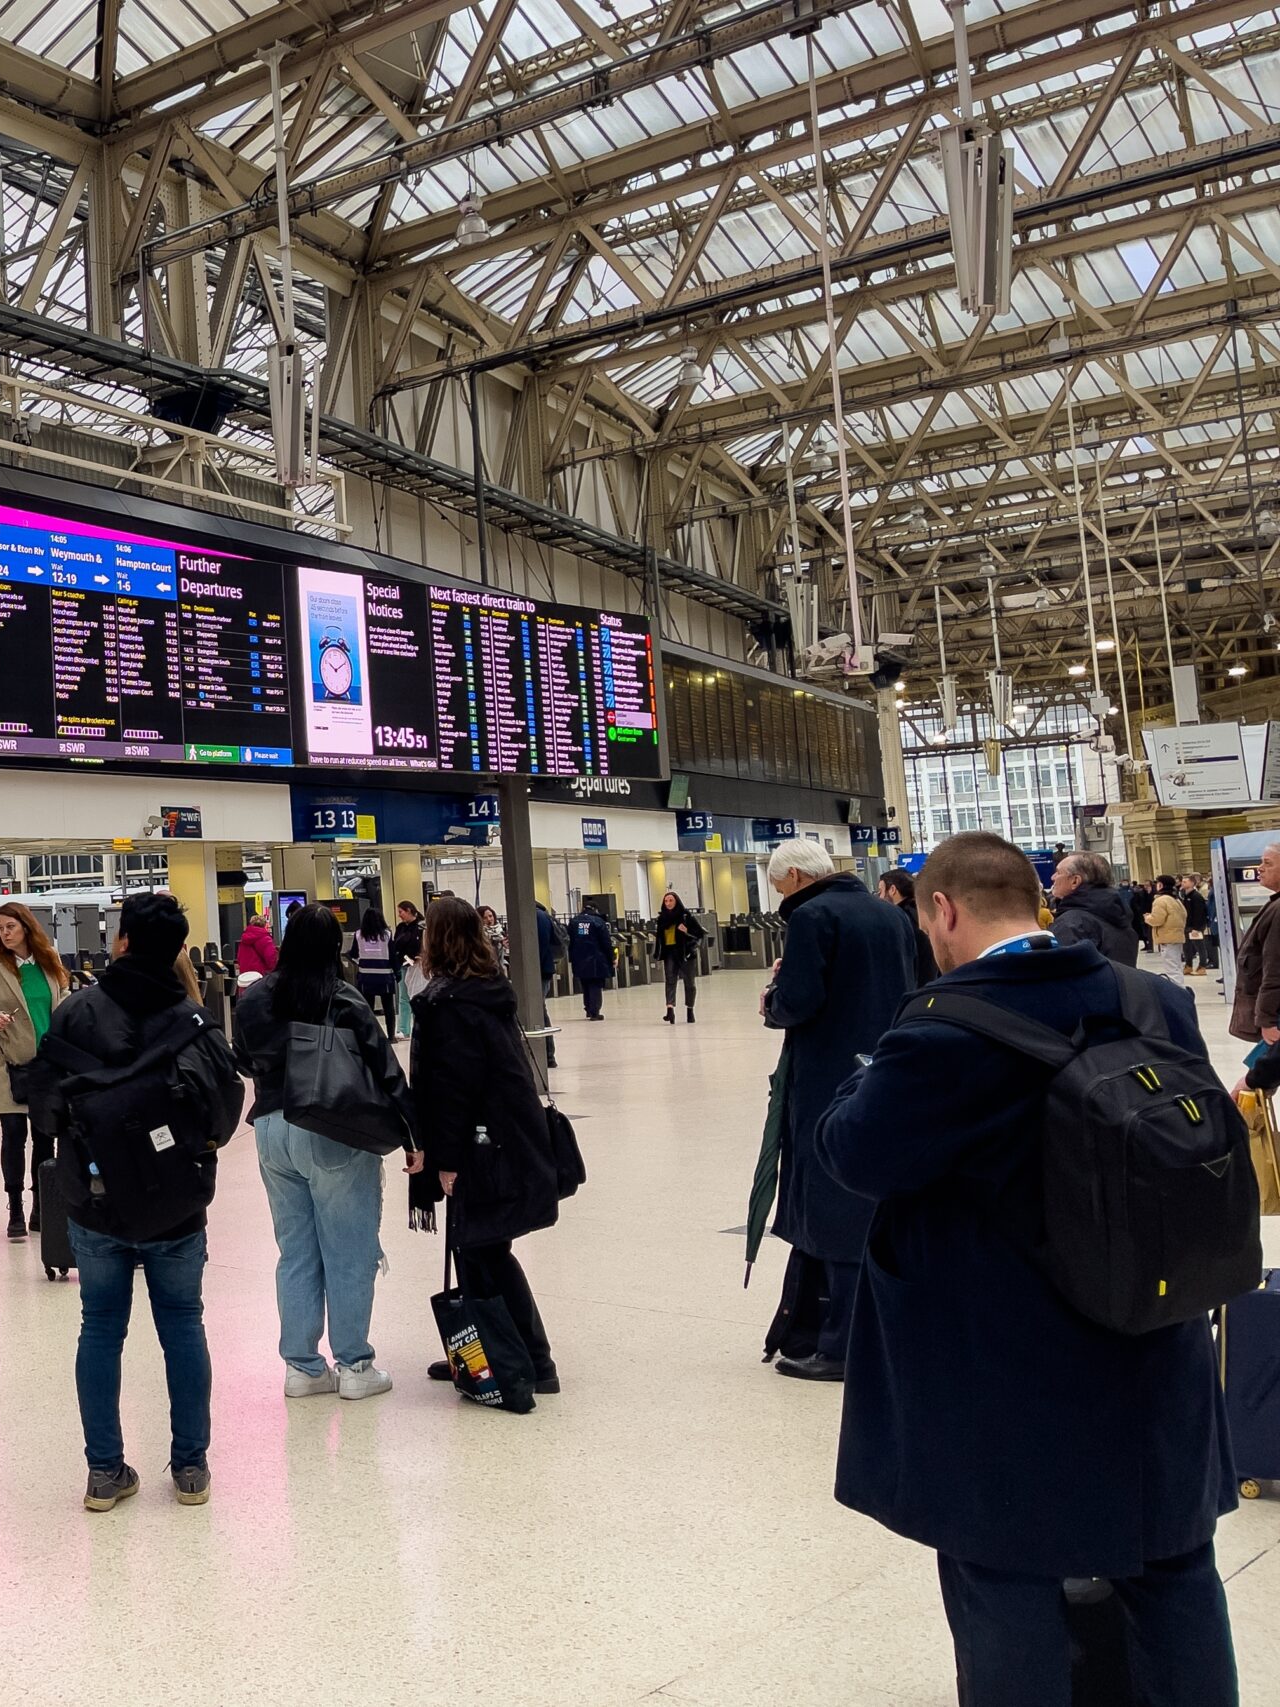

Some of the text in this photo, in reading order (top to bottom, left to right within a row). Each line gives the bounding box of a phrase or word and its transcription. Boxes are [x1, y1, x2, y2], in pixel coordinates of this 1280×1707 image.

[50, 534, 68, 545] 14:05
[10, 543, 17, 553] &
[17, 544, 34, 555] Eton
[115, 543, 132, 554] 14:06
[51, 547, 103, 565] Weymouth &
[51, 562, 64, 572] Wait
[116, 557, 172, 574] Hampton Court
[179, 555, 221, 575] Further
[52, 571, 78, 586] 12-19
[116, 571, 129, 581] Wait
[117, 580, 131, 592] 1-6
[180, 577, 243, 600] Departures
[366, 582, 400, 600] Special
[430, 586, 536, 613] Next fastest direct train to
[368, 602, 404, 619] Notices
[600, 613, 623, 627] Status
[375, 725, 428, 749] 13:45 51
[66, 742, 86, 754] SWR
[131, 745, 150, 757] SWR
[199, 749, 233, 760] Go to platform
[254, 750, 279, 760] Please wait
[468, 800, 490, 817] 14
[186, 813, 201, 822] WiFi
[314, 810, 336, 829] 13
[341, 809, 356, 829] 13
[686, 816, 704, 829] 15
[776, 823, 792, 835] 16
[856, 829, 870, 840] 17
[882, 831, 897, 842] 18
[578, 922, 590, 930] SW
[450, 1325, 477, 1343] ANIMAL
[464, 1331, 479, 1344] CAT
